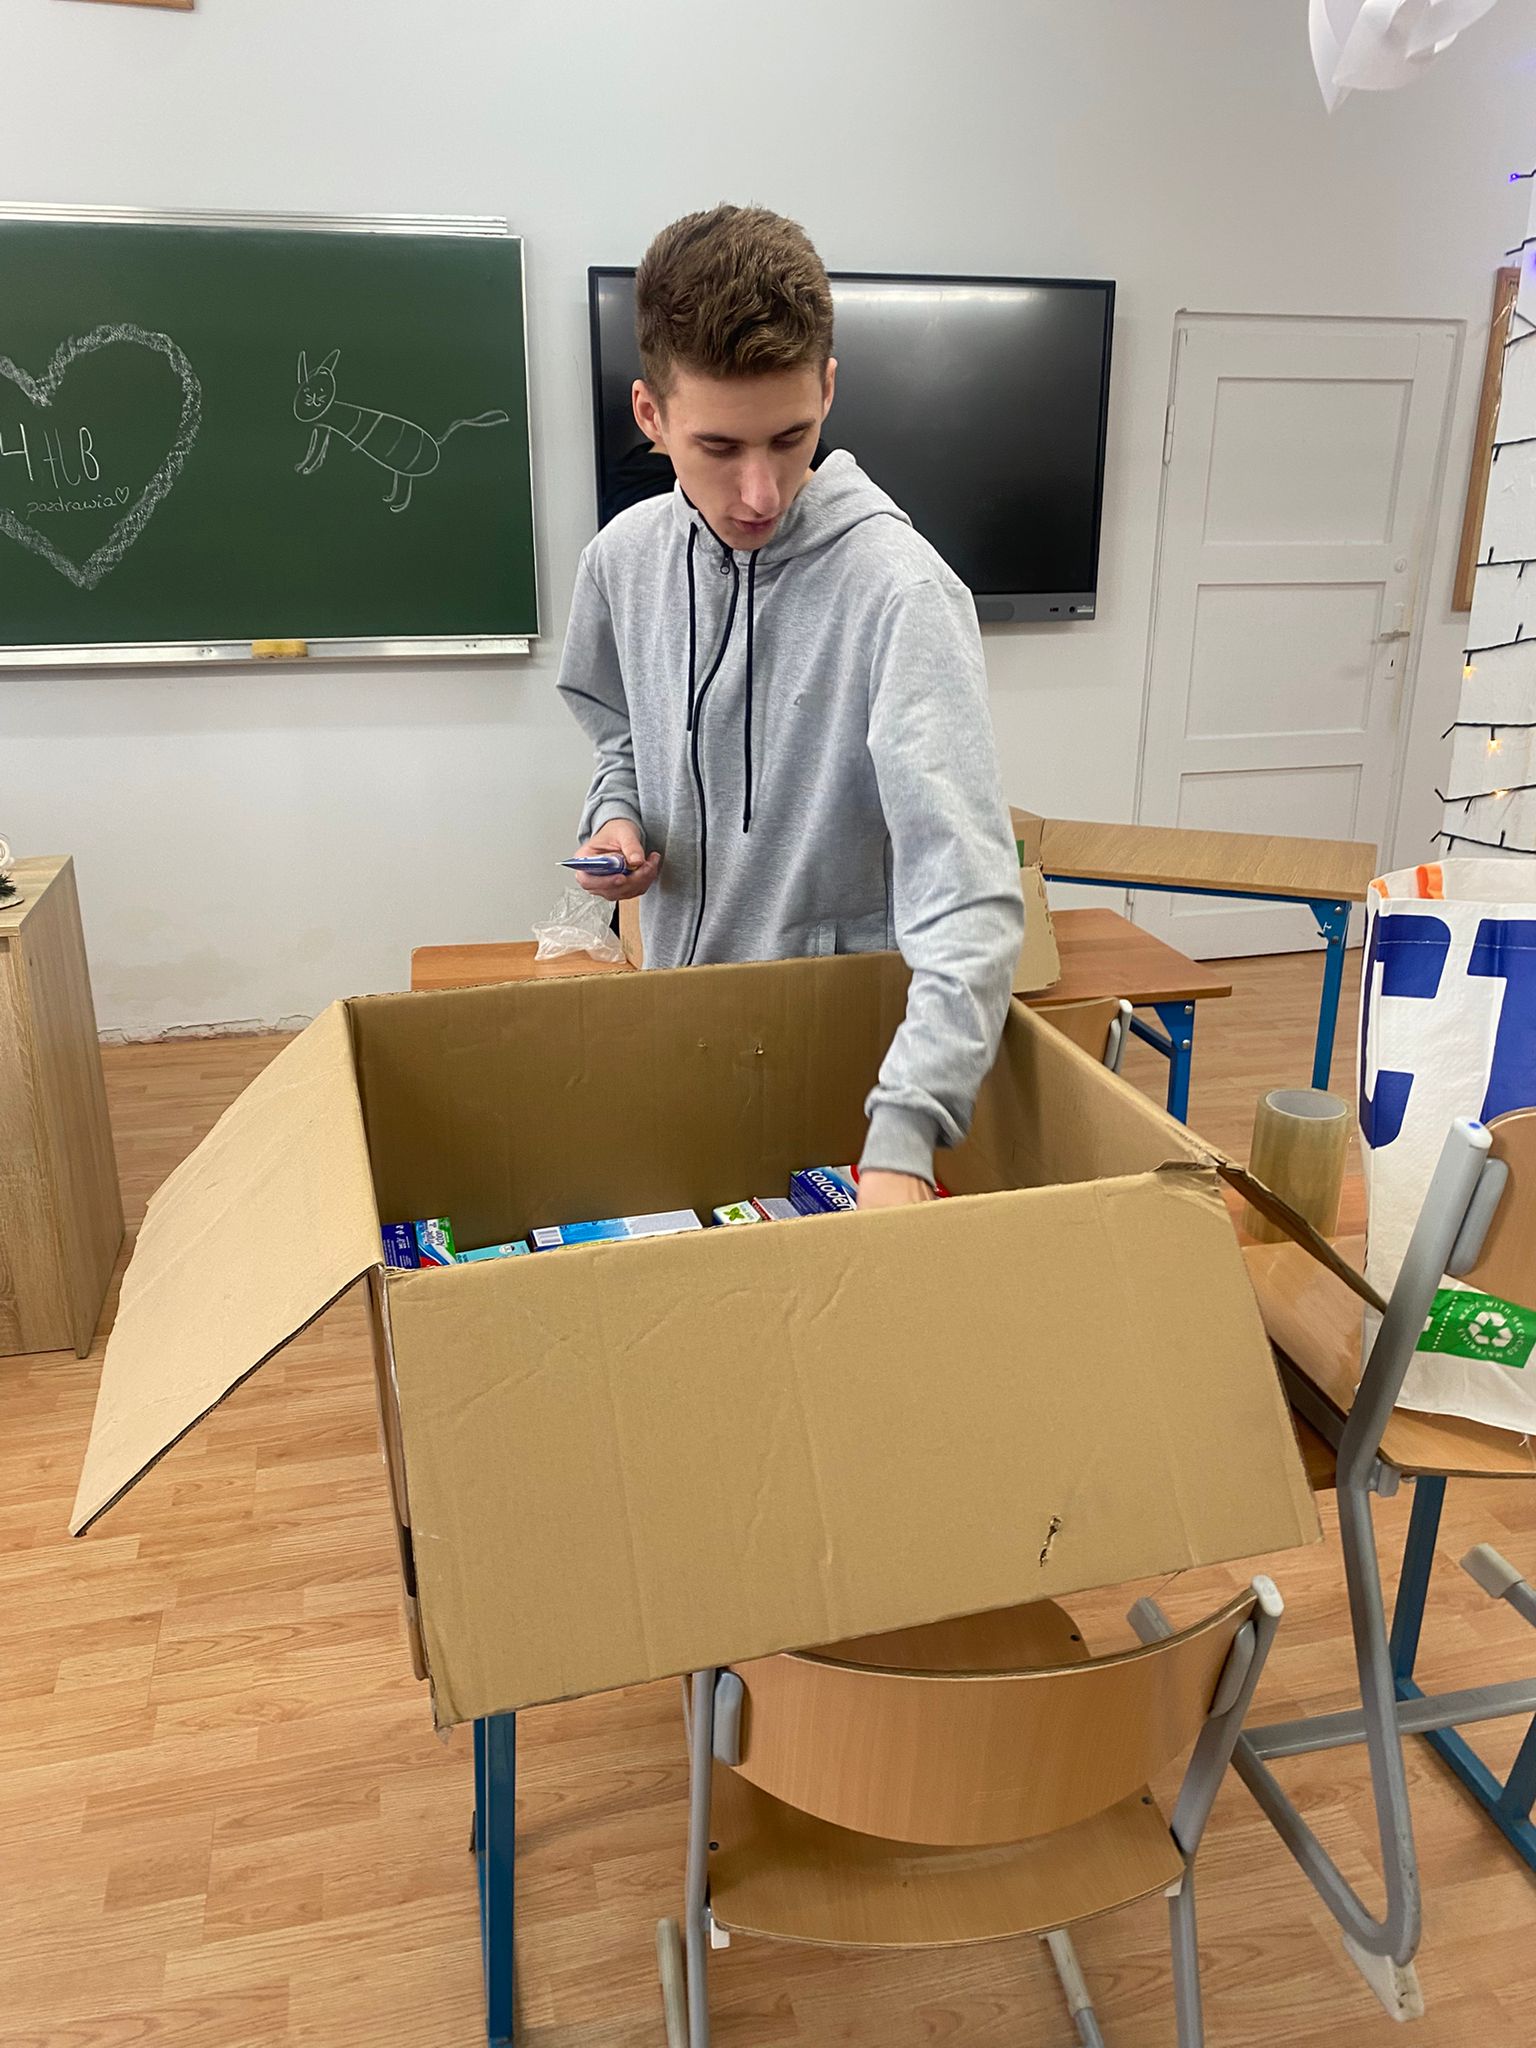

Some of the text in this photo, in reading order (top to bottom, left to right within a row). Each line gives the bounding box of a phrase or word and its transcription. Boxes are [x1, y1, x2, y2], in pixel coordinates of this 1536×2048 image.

[26, 494, 117, 521] pozdrawia
[806, 1169, 855, 1211] coloden
[1458, 1301, 1481, 1321] MADE
[1484, 1300, 1513, 1315] WITH
